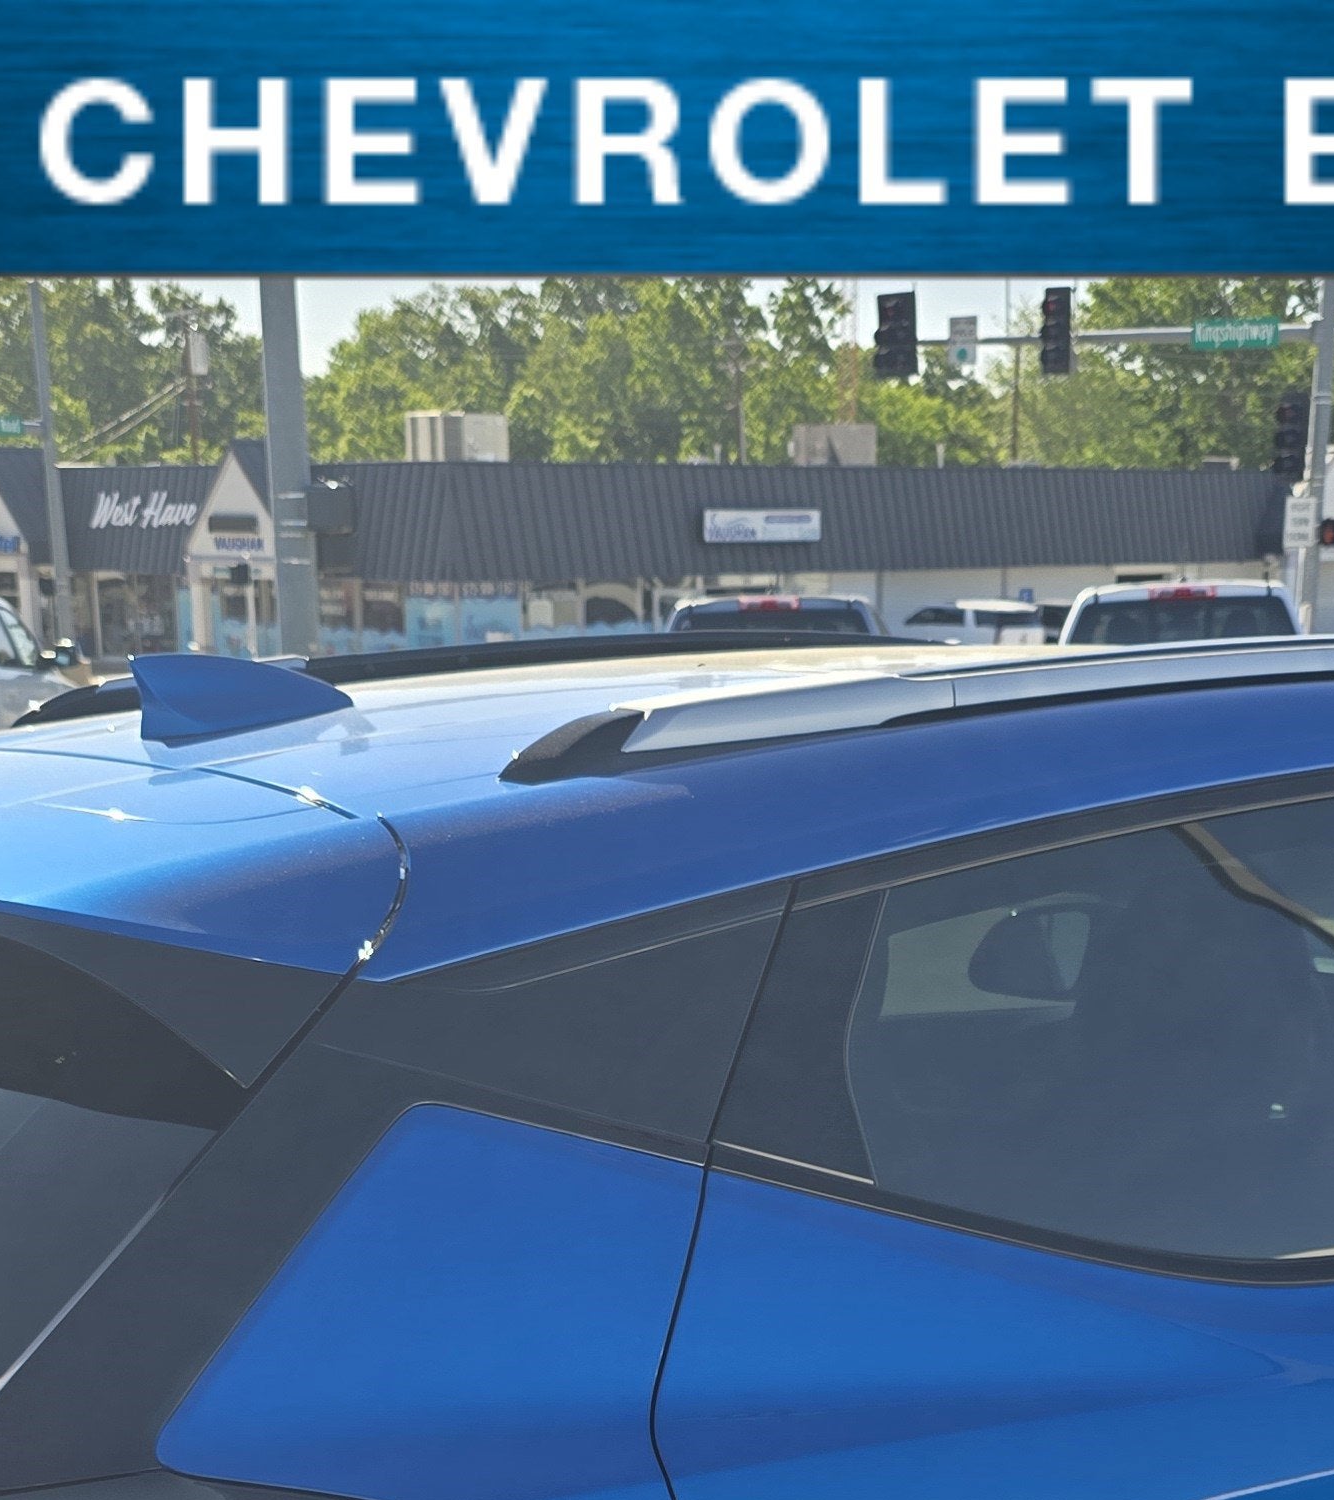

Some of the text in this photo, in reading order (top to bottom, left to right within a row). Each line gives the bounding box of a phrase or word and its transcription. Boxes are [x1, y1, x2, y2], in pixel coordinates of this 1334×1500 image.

[1195, 322, 1275, 348] Kingshighway
[91, 492, 141, 528] West
[214, 537, 265, 550] VAUGHAN
